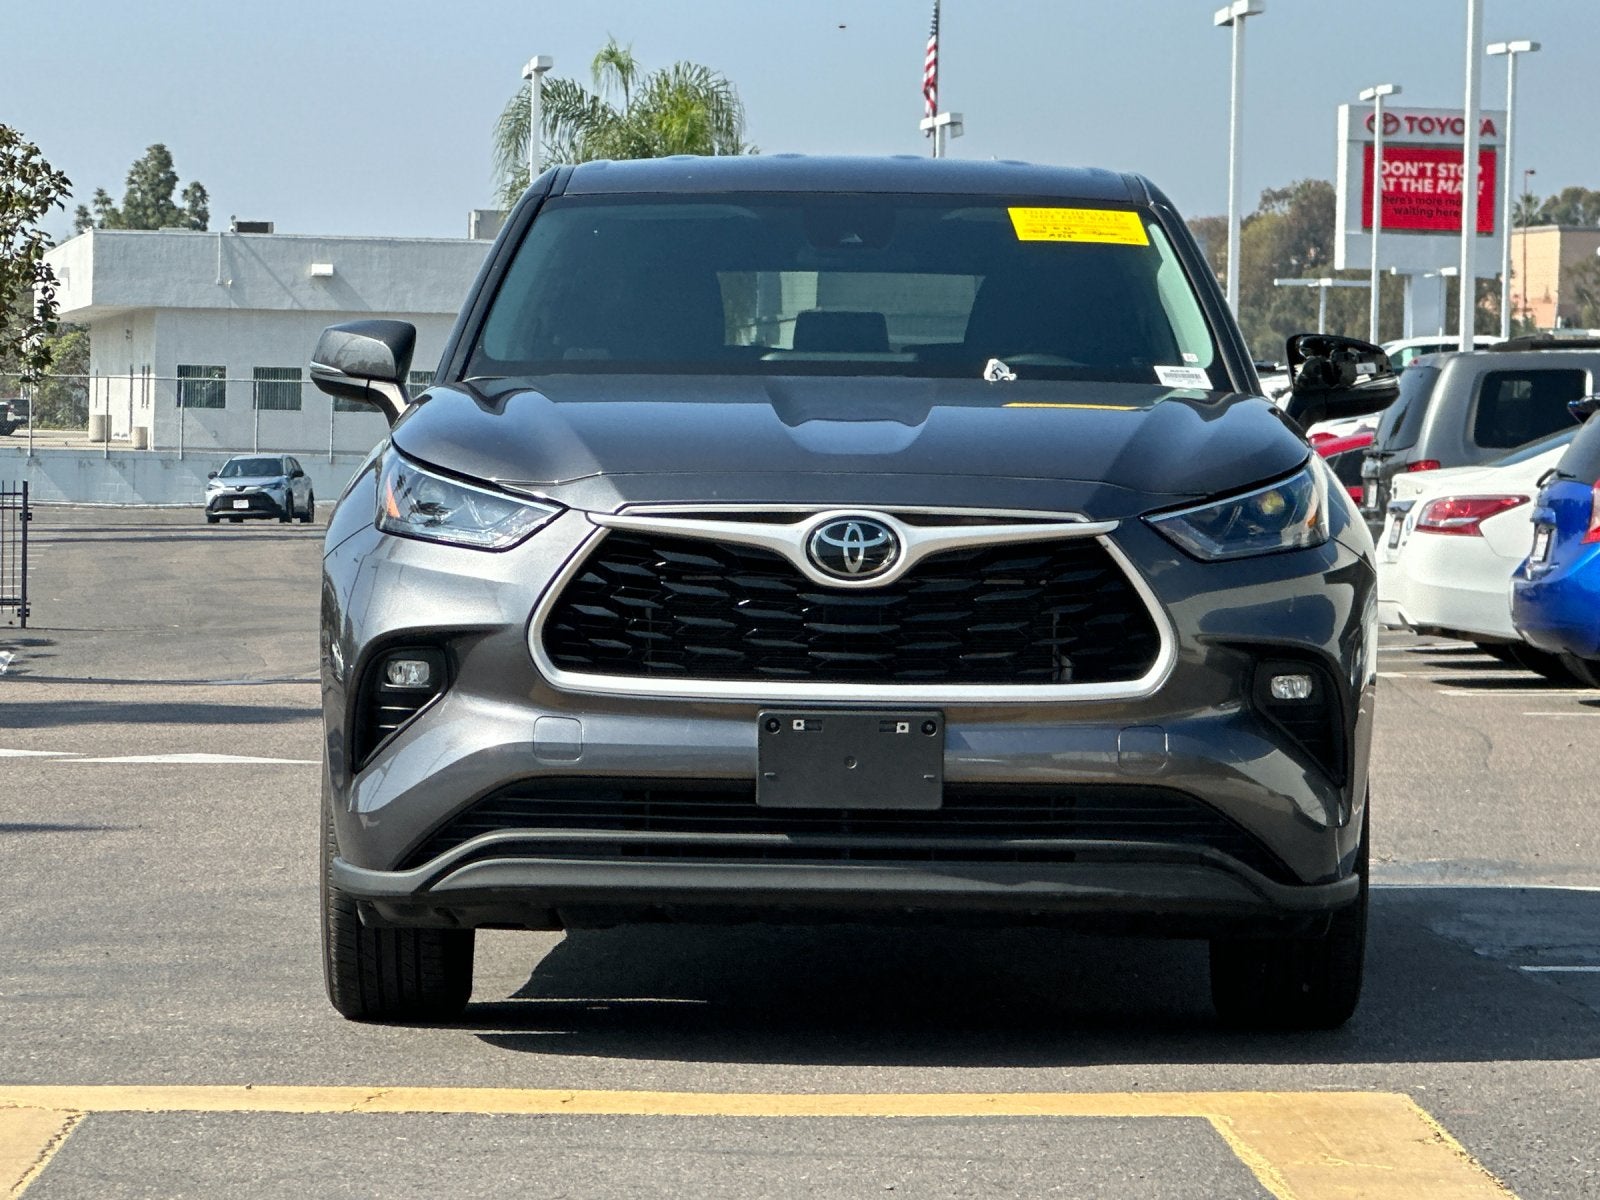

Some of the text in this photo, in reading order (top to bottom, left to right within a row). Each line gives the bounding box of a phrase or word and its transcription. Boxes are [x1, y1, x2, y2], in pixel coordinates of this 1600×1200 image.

[1404, 115, 1497, 137] TOYOA
[1380, 161, 1435, 177] DON'T
[1399, 178, 1434, 193] THE
[1382, 195, 1412, 205] here's
[1416, 197, 1443, 206] more
[1394, 207, 1434, 219] waiting
